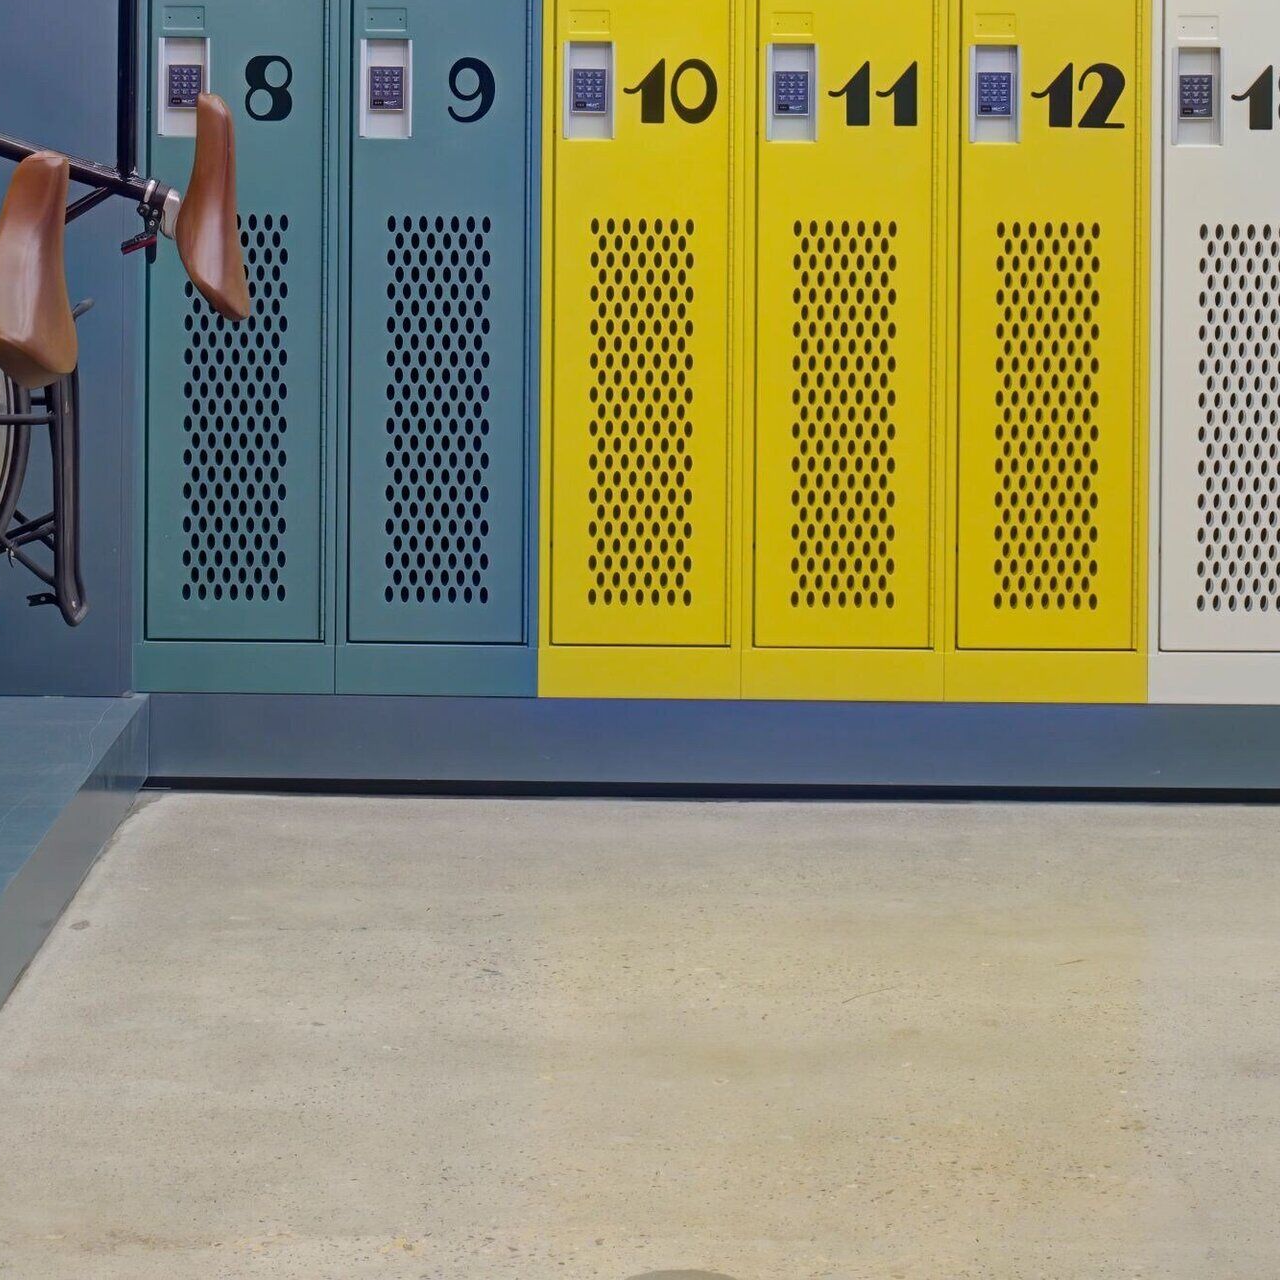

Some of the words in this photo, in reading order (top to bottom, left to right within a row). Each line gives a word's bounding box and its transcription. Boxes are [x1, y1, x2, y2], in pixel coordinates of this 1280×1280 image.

[245, 56, 292, 121] 8
[448, 57, 495, 123] 9
[623, 59, 717, 124] 10
[828, 61, 917, 126] 11
[1031, 63, 1125, 128] 12
